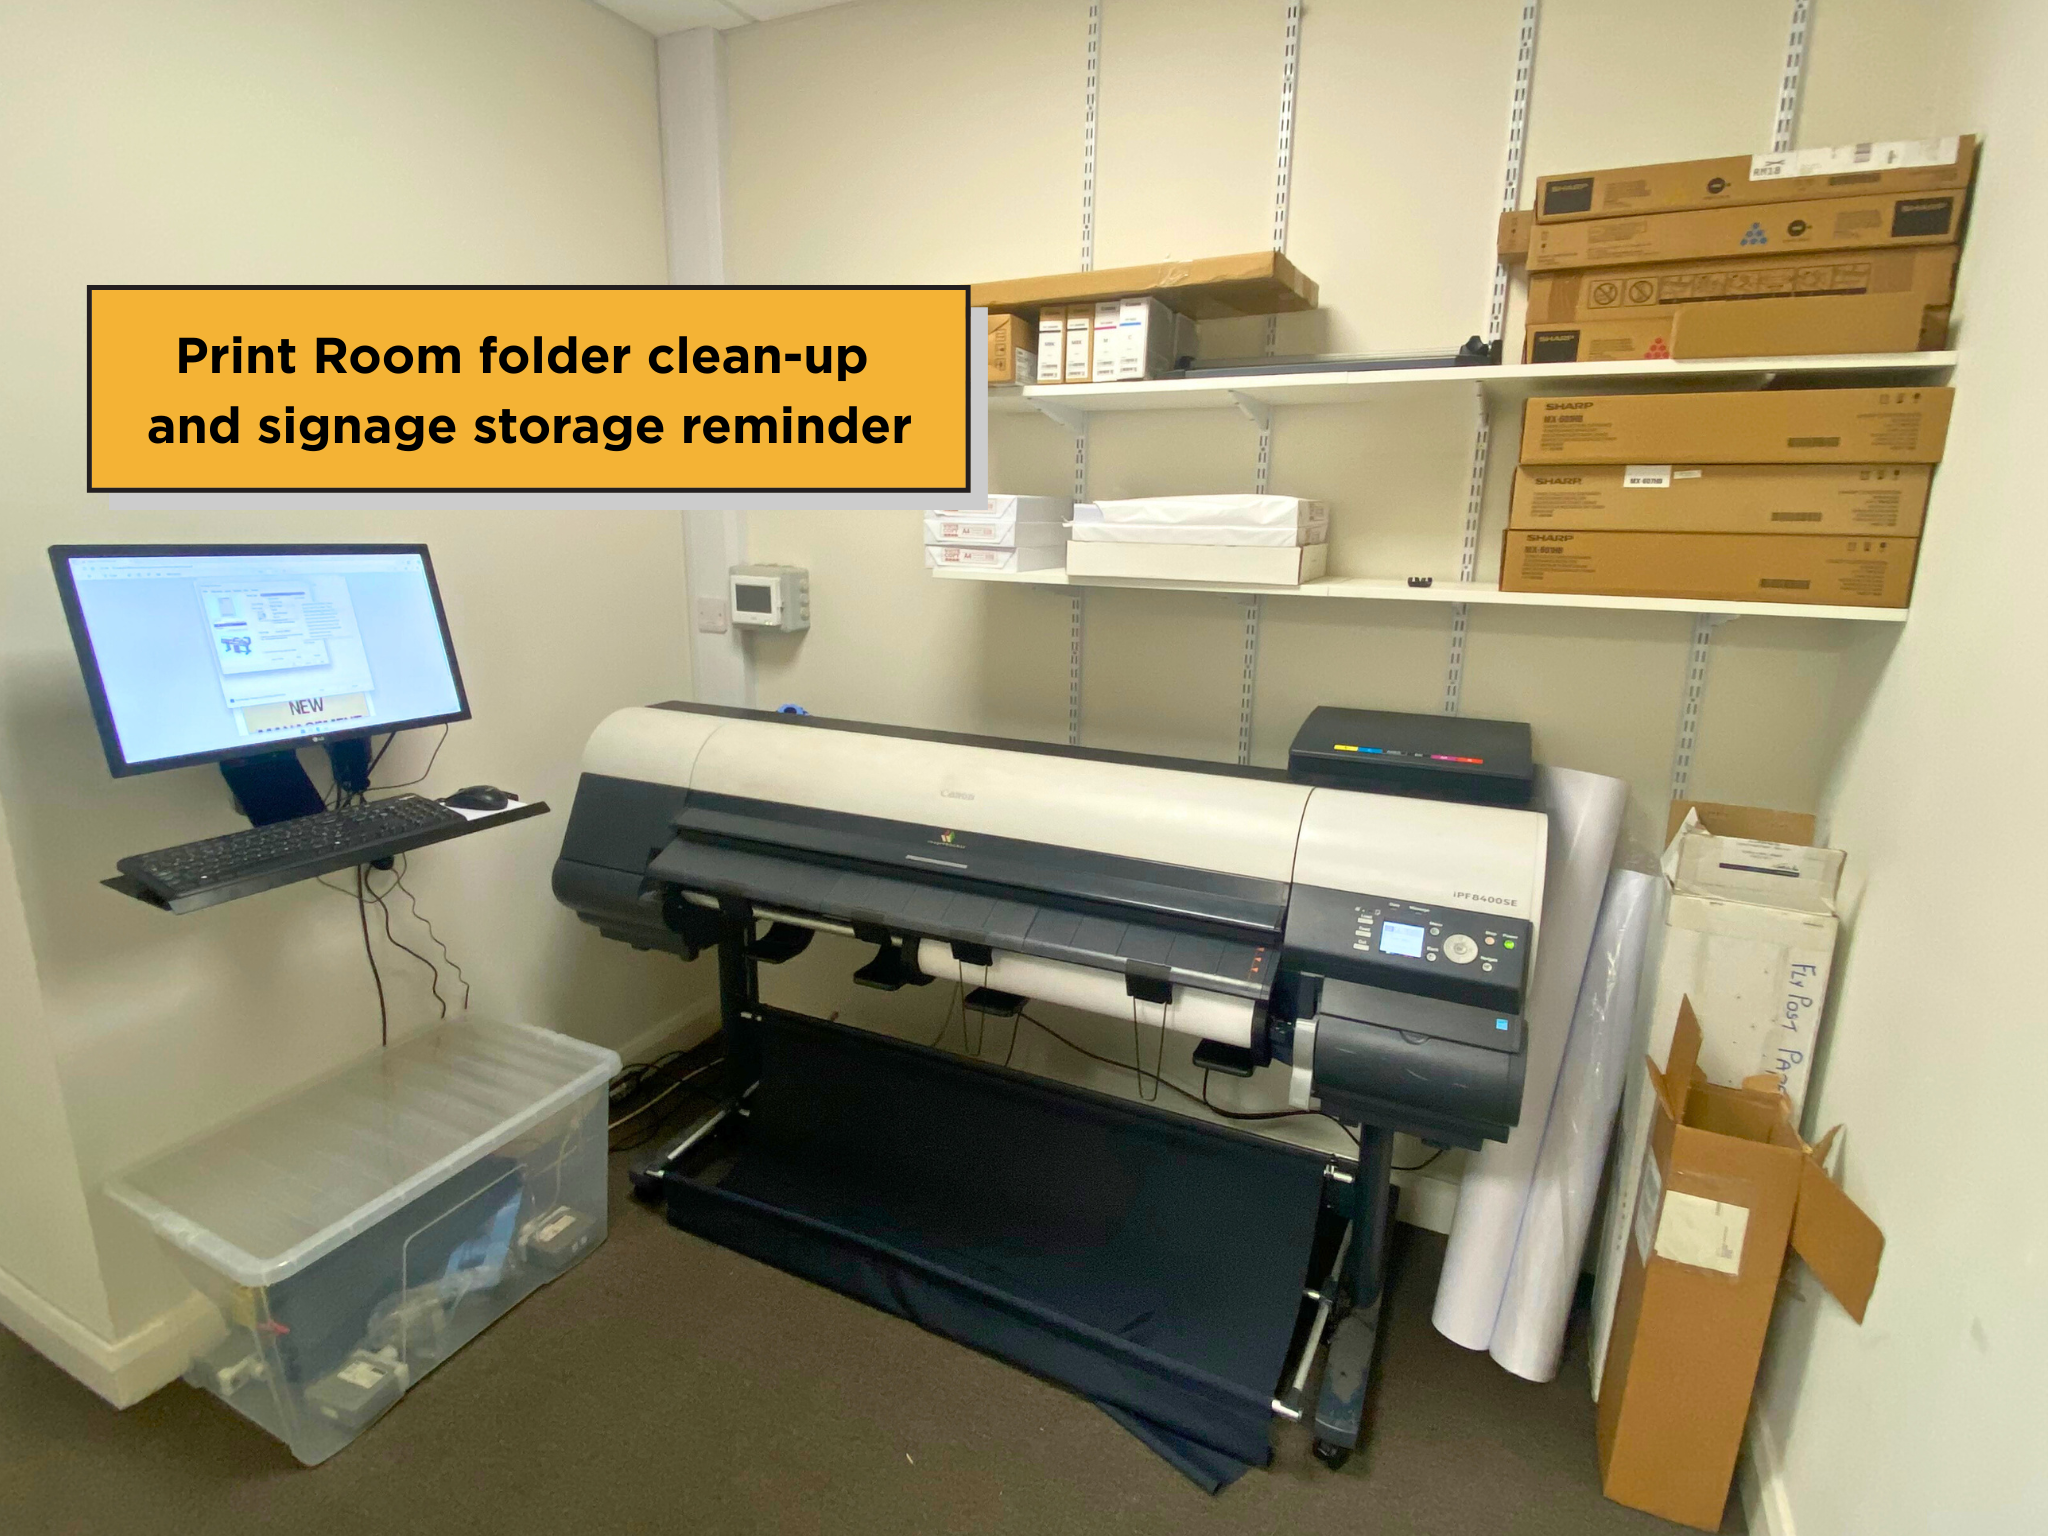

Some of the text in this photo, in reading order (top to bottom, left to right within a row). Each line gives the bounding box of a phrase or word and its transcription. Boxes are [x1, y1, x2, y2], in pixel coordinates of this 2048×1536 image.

[1545, 402, 1594, 411] SHARP
[1535, 477, 1582, 485] SHARP
[1527, 534, 1574, 542] SHARP
[289, 697, 324, 716] NEW
[940, 789, 976, 801] Canon
[1453, 891, 1518, 907] iPF8400SE
